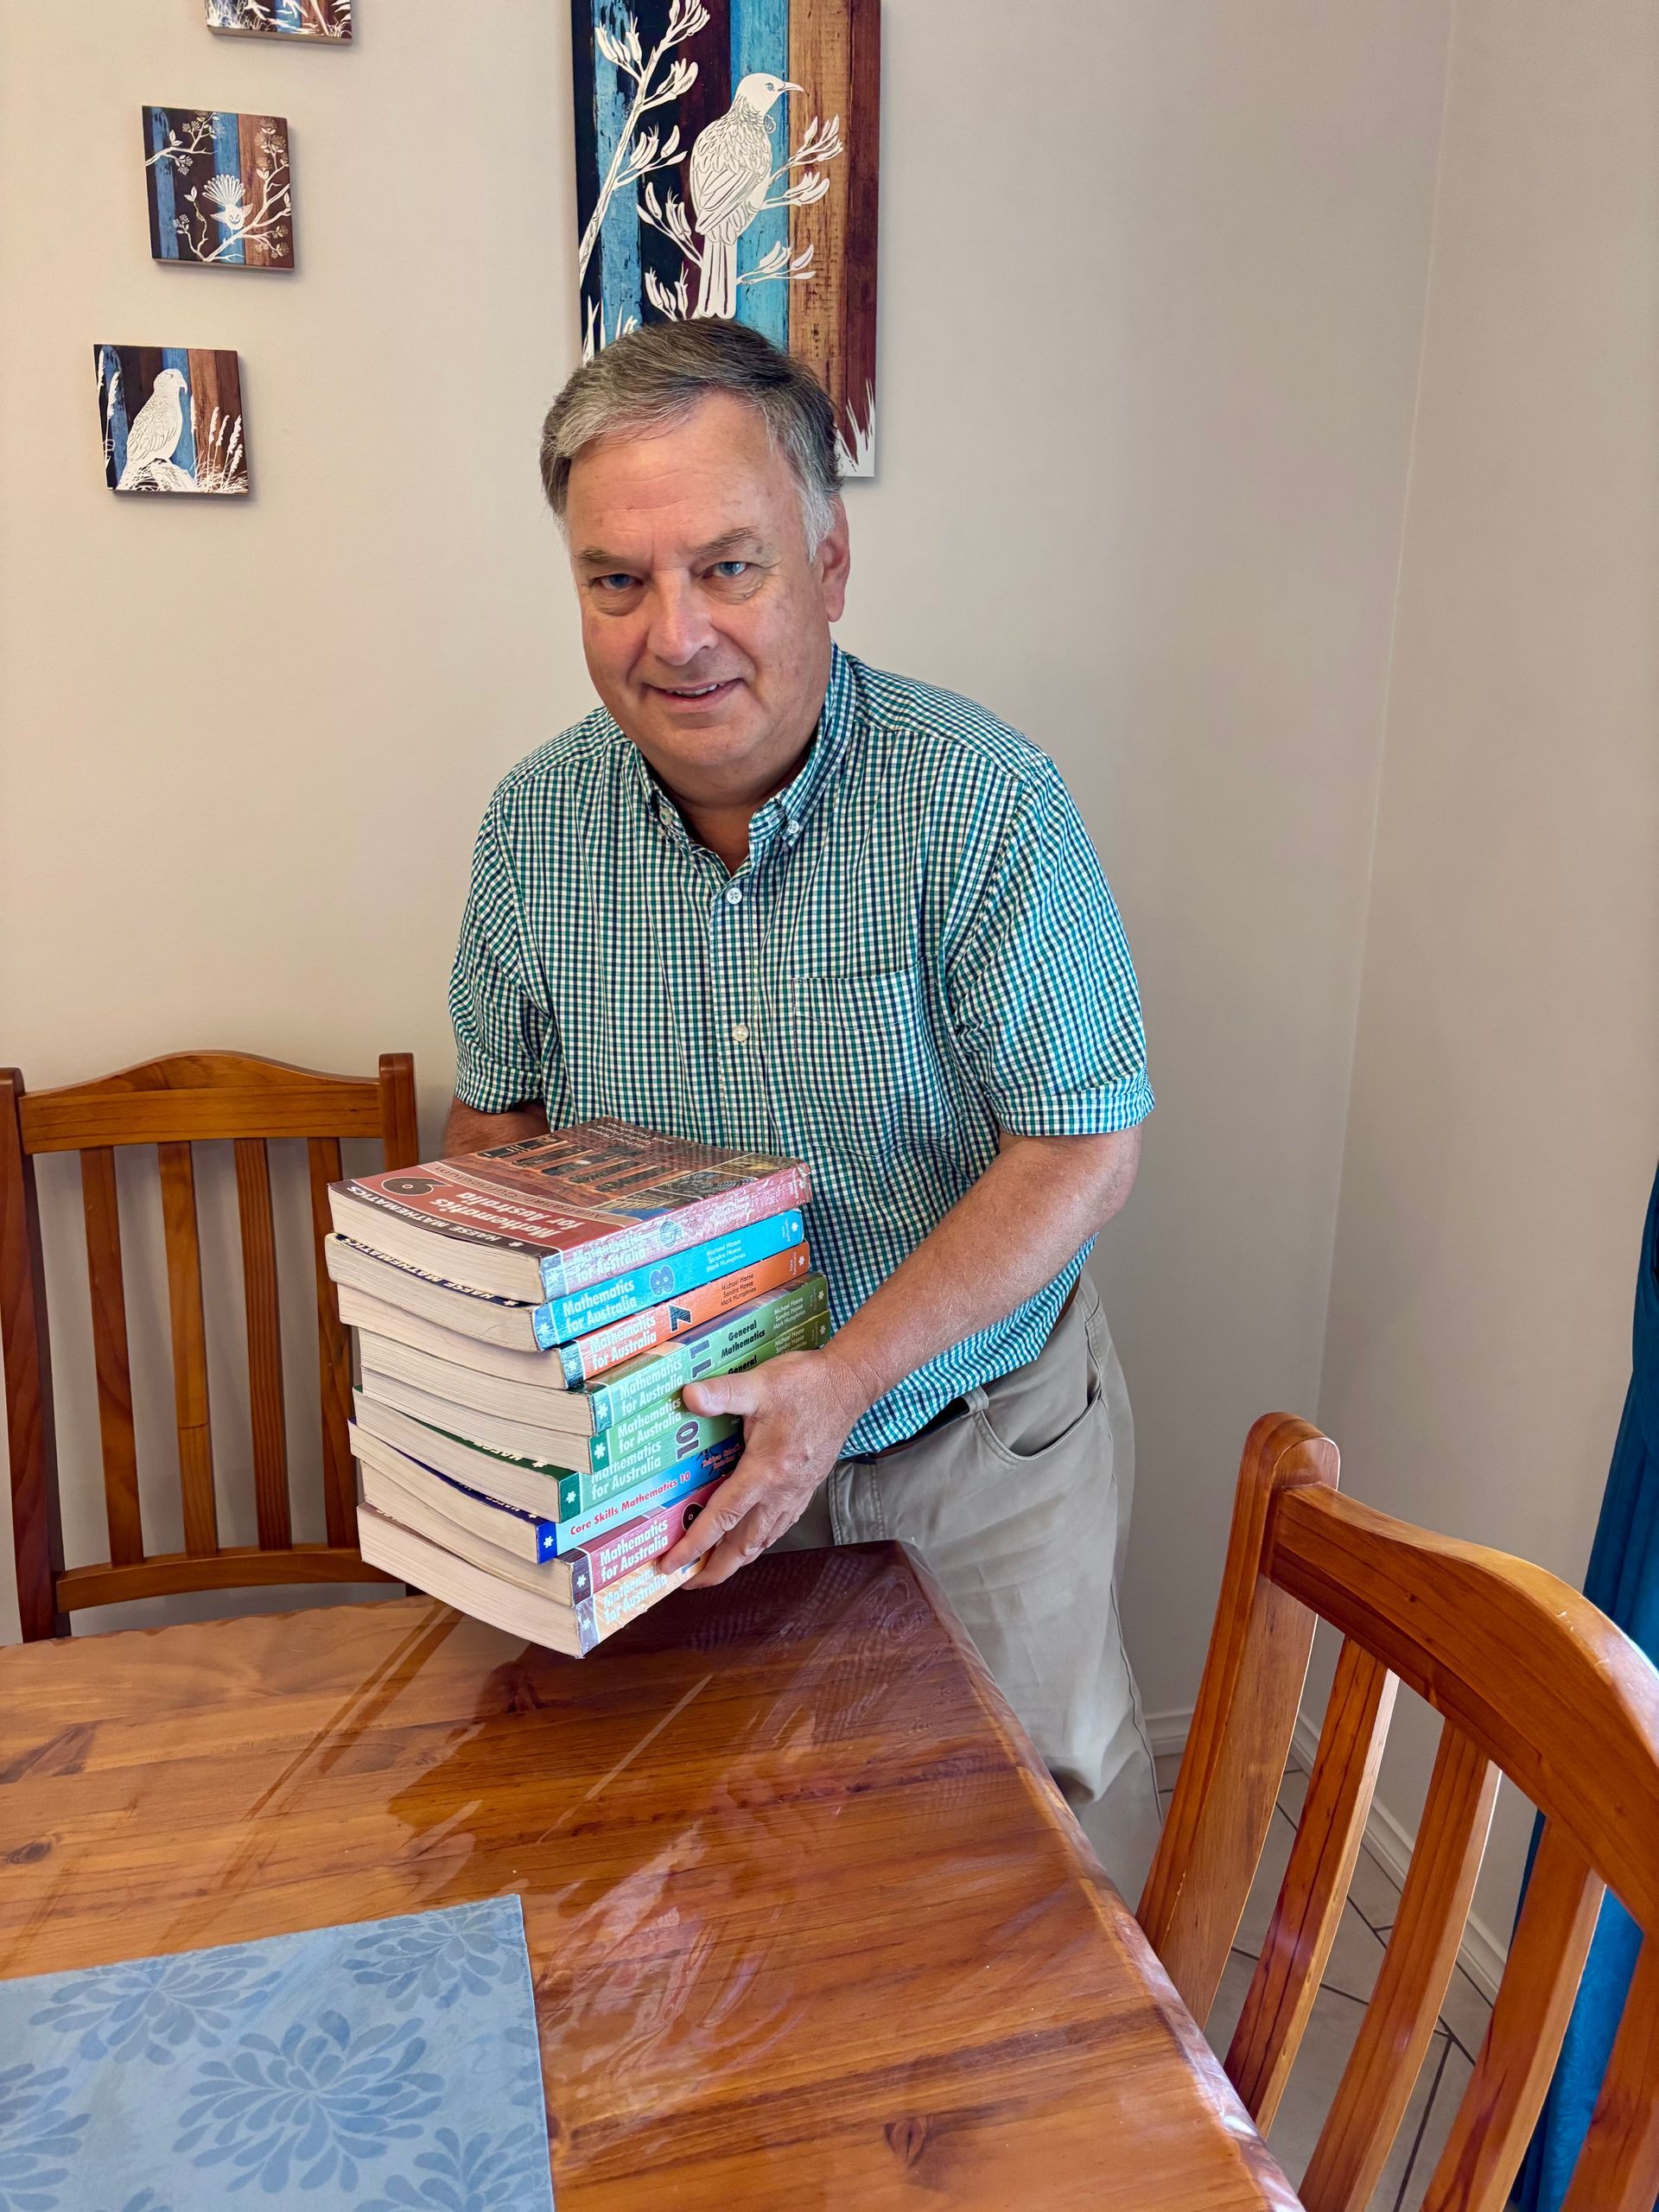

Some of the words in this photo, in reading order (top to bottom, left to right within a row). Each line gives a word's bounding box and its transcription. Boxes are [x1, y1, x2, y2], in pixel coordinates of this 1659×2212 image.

[435, 1166, 518, 1198] Curriculum
[346, 1185, 449, 1228] MATHEMATICS
[429, 1198, 563, 1238] Mathematics
[455, 1192, 552, 1222] Australia
[524, 1197, 605, 1219] Australian
[545, 1217, 586, 1230] for
[449, 1225, 502, 1242] HAESE
[563, 1280, 635, 1317] Mathematics
[650, 1265, 675, 1296] 8
[566, 1318, 584, 1334] for
[586, 1297, 637, 1326] Australia
[668, 1304, 692, 1333] 7
[774, 1302, 790, 1315] Michael
[791, 1297, 804, 1306] Haese
[775, 1311, 790, 1322] Sandra
[791, 1305, 804, 1313] Haese
[589, 1314, 656, 1353] Mathematics
[721, 1329, 766, 1358] Mathematics
[728, 1319, 757, 1342] General
[773, 1321, 784, 1331] Mark
[591, 1354, 610, 1370] for
[611, 1332, 657, 1362] Australia
[690, 1338, 712, 1379] 11
[620, 1359, 683, 1398] Mathematics
[621, 1400, 637, 1416] for
[639, 1375, 683, 1407] Australia
[618, 1396, 681, 1440] Mathematics
[618, 1439, 635, 1454] for
[638, 1411, 682, 1445] Australia
[676, 1421, 700, 1462] 10
[591, 1484, 610, 1501] for
[612, 1456, 662, 1491] Australia
[570, 1520, 592, 1536] Core
[594, 1506, 620, 1526] Skills
[621, 1479, 677, 1512] Mathematics
[679, 1471, 691, 1484] 10
[601, 1518, 668, 1567] Mathematics
[601, 1566, 619, 1584] for
[620, 1535, 669, 1573] Australia
[605, 1606, 620, 1624] for
[622, 1575, 668, 1610] Australia
